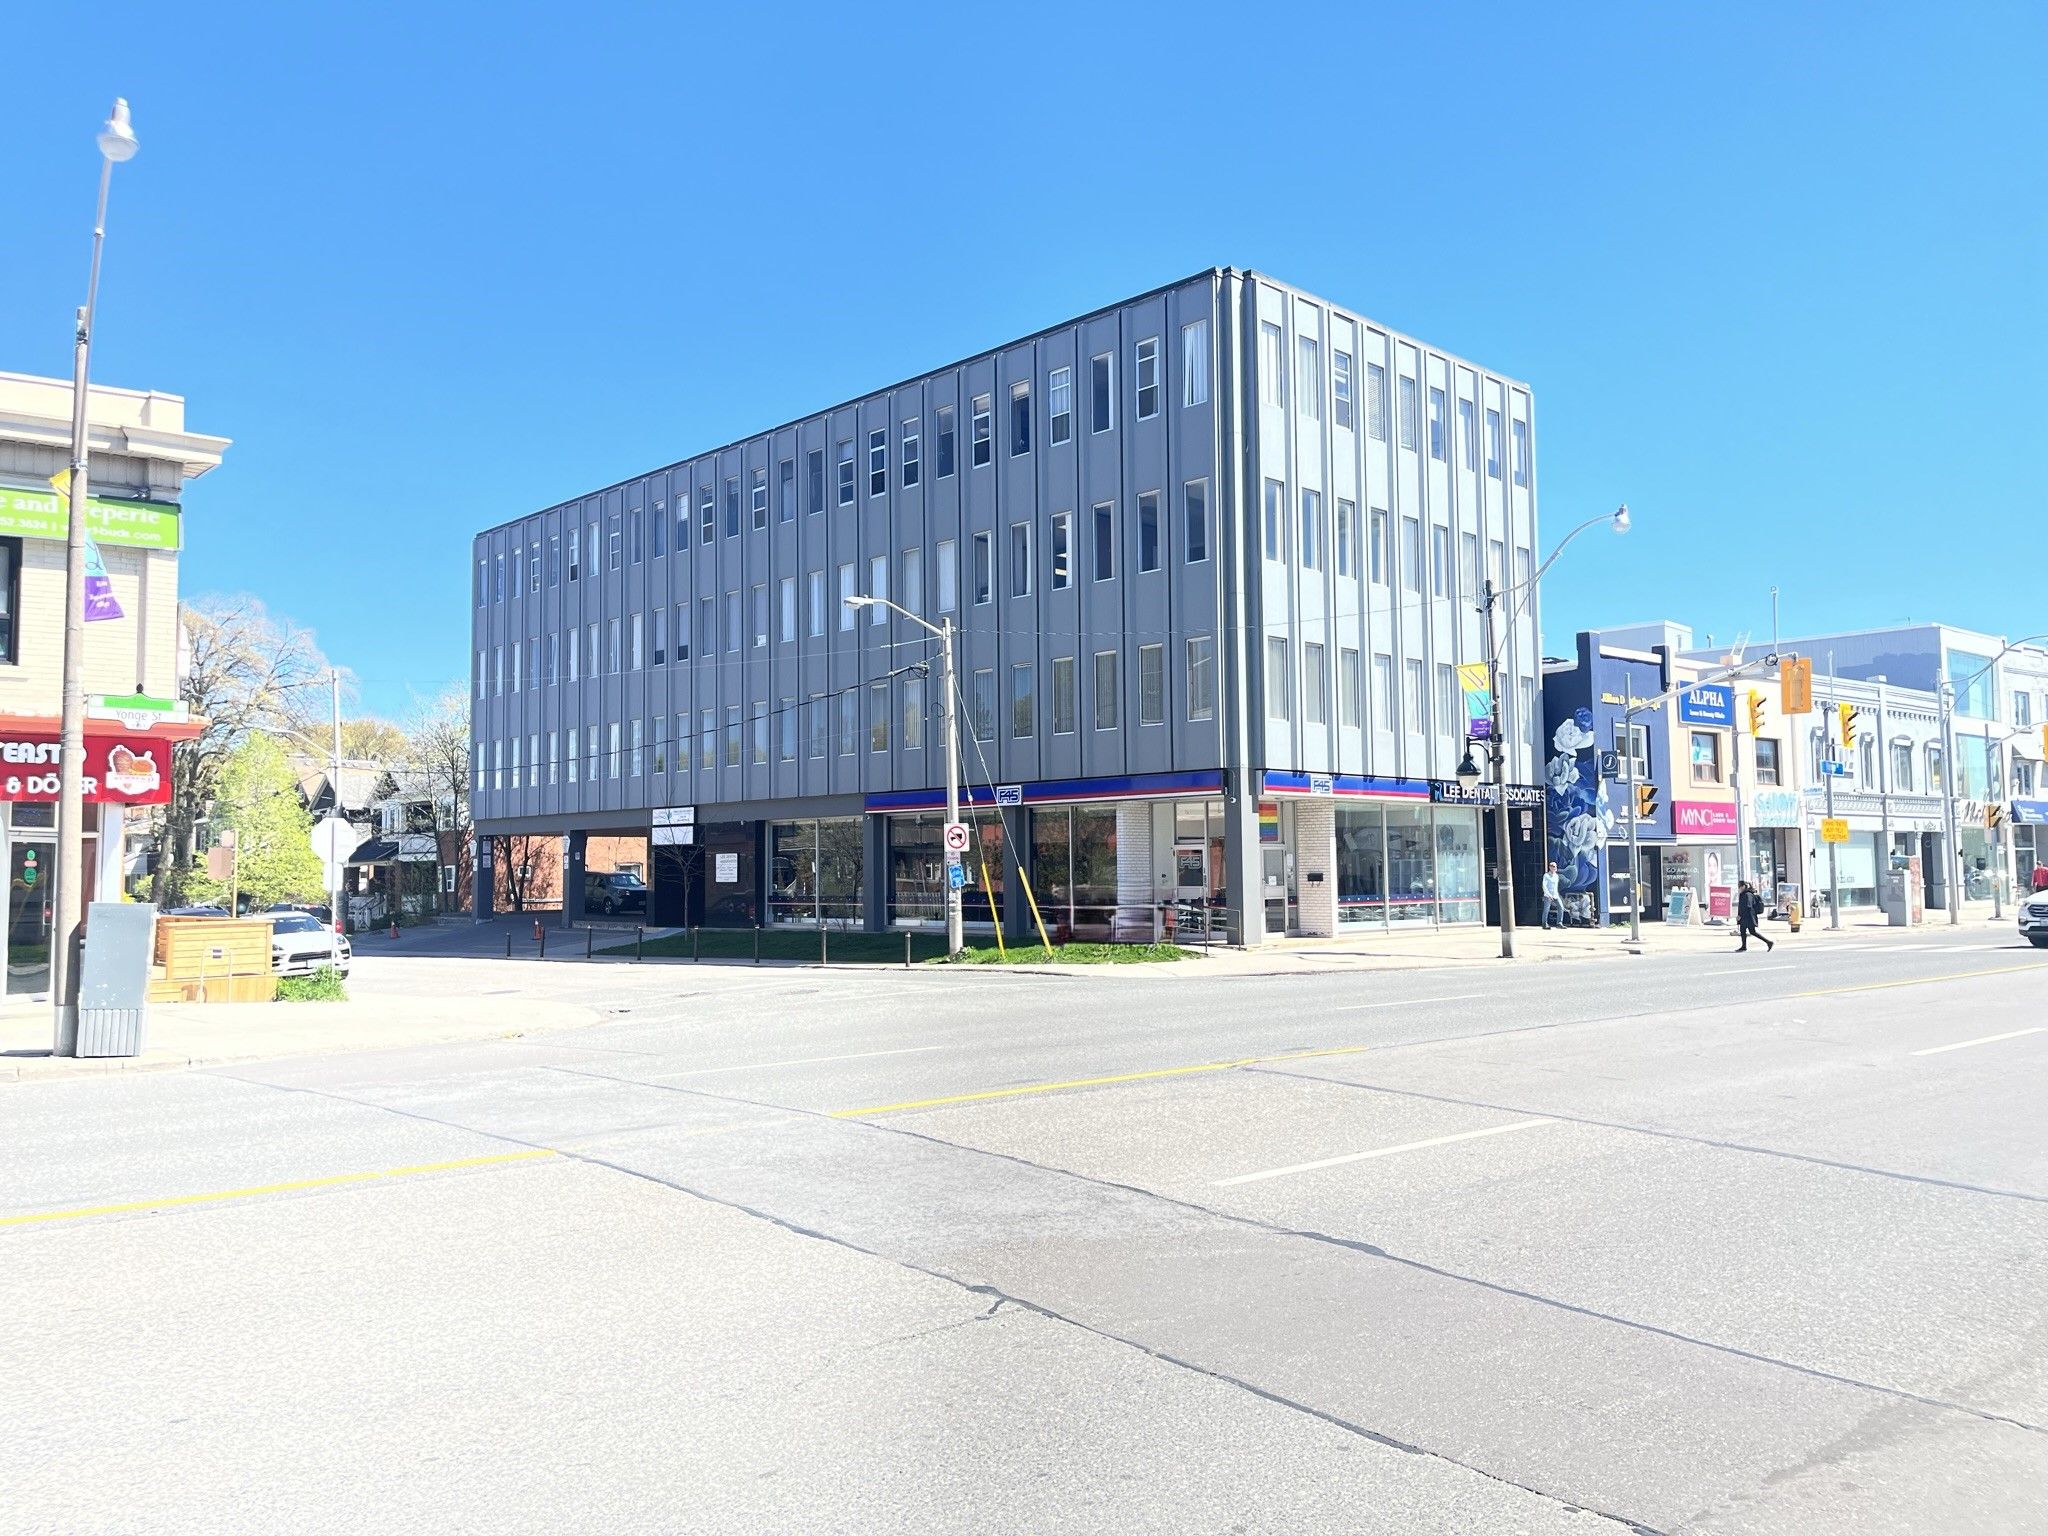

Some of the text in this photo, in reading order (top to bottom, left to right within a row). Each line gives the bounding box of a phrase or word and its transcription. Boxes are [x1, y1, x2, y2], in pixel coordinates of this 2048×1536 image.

[13, 496, 59, 514] and
[1689, 690, 1725, 707] ALPHA
[116, 710, 162, 721] Yonge St
[6, 776, 21, 794] &
[1313, 778, 1331, 793] F45
[1443, 782, 1460, 798] LEE
[1496, 787, 1545, 803] SSOCIATES
[998, 787, 1020, 804] F45
[1179, 856, 1201, 869] F45
